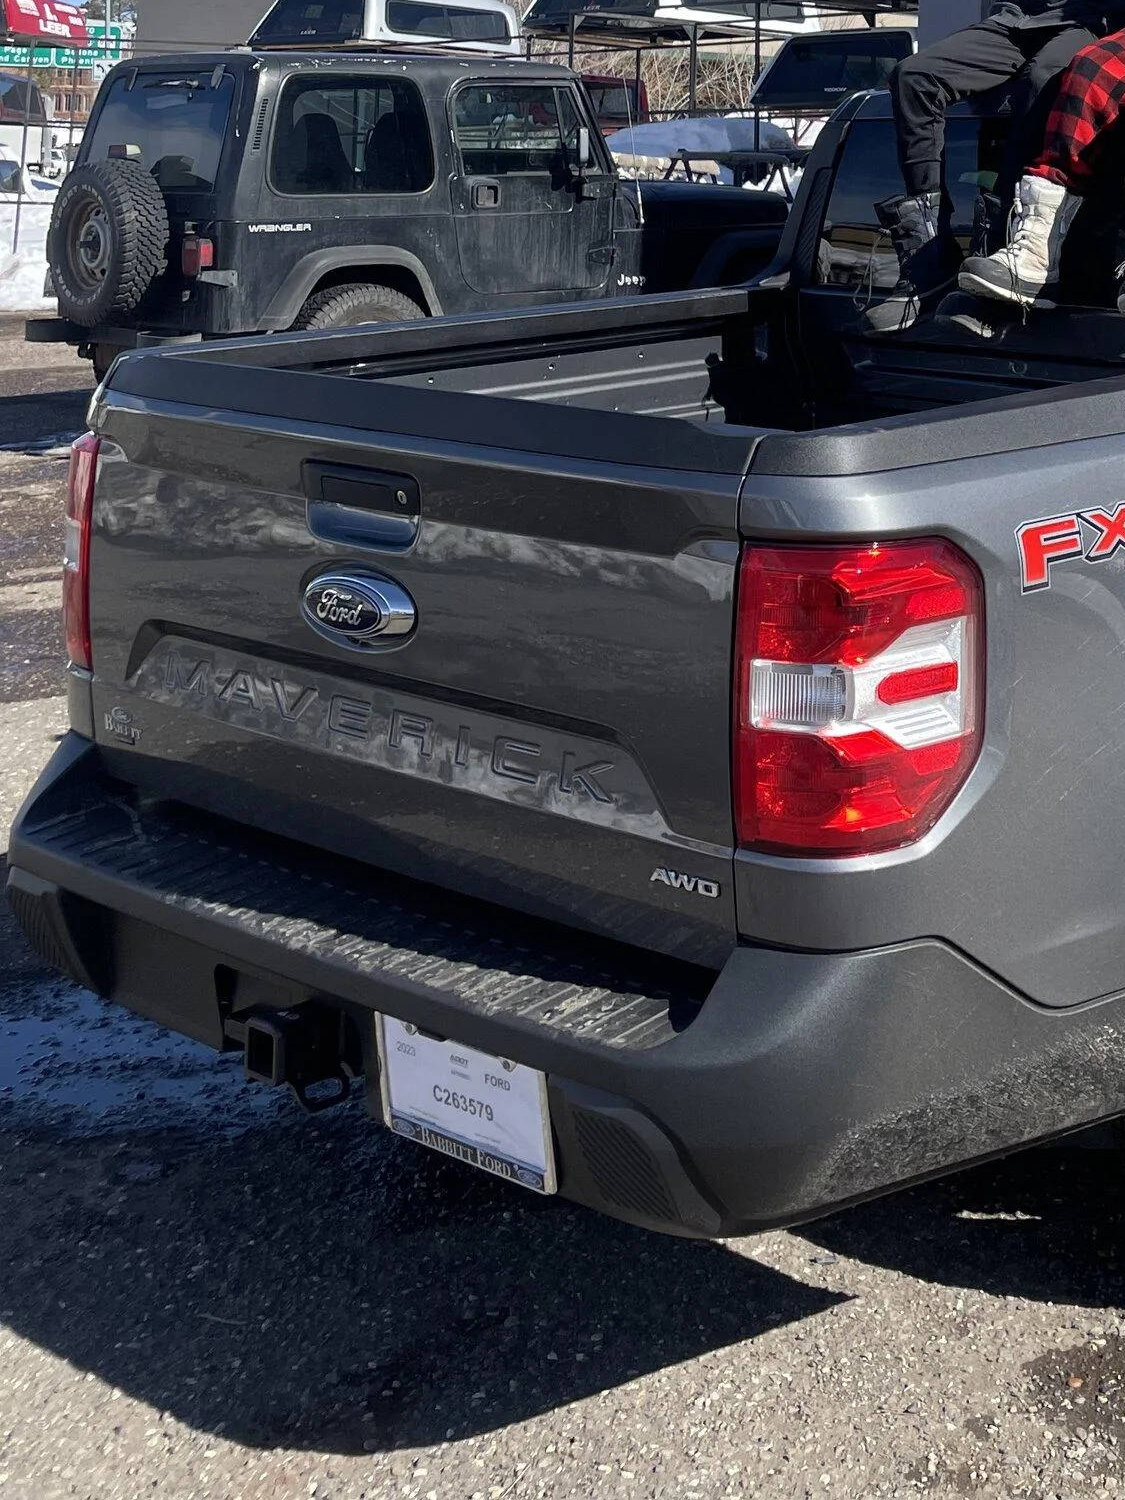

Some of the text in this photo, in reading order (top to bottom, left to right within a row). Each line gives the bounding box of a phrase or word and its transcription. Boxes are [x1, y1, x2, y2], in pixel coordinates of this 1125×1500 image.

[38, 19, 72, 38] LEER
[248, 223, 311, 233] WRANGLER
[617, 273, 646, 287] Jeep
[316, 588, 363, 626] Ford
[163, 649, 617, 806] MAVERICK
[650, 867, 720, 899] AWD
[484, 1073, 511, 1092] FORD
[433, 1084, 494, 1122] C263579
[420, 1127, 512, 1178] BABBITT FORD
